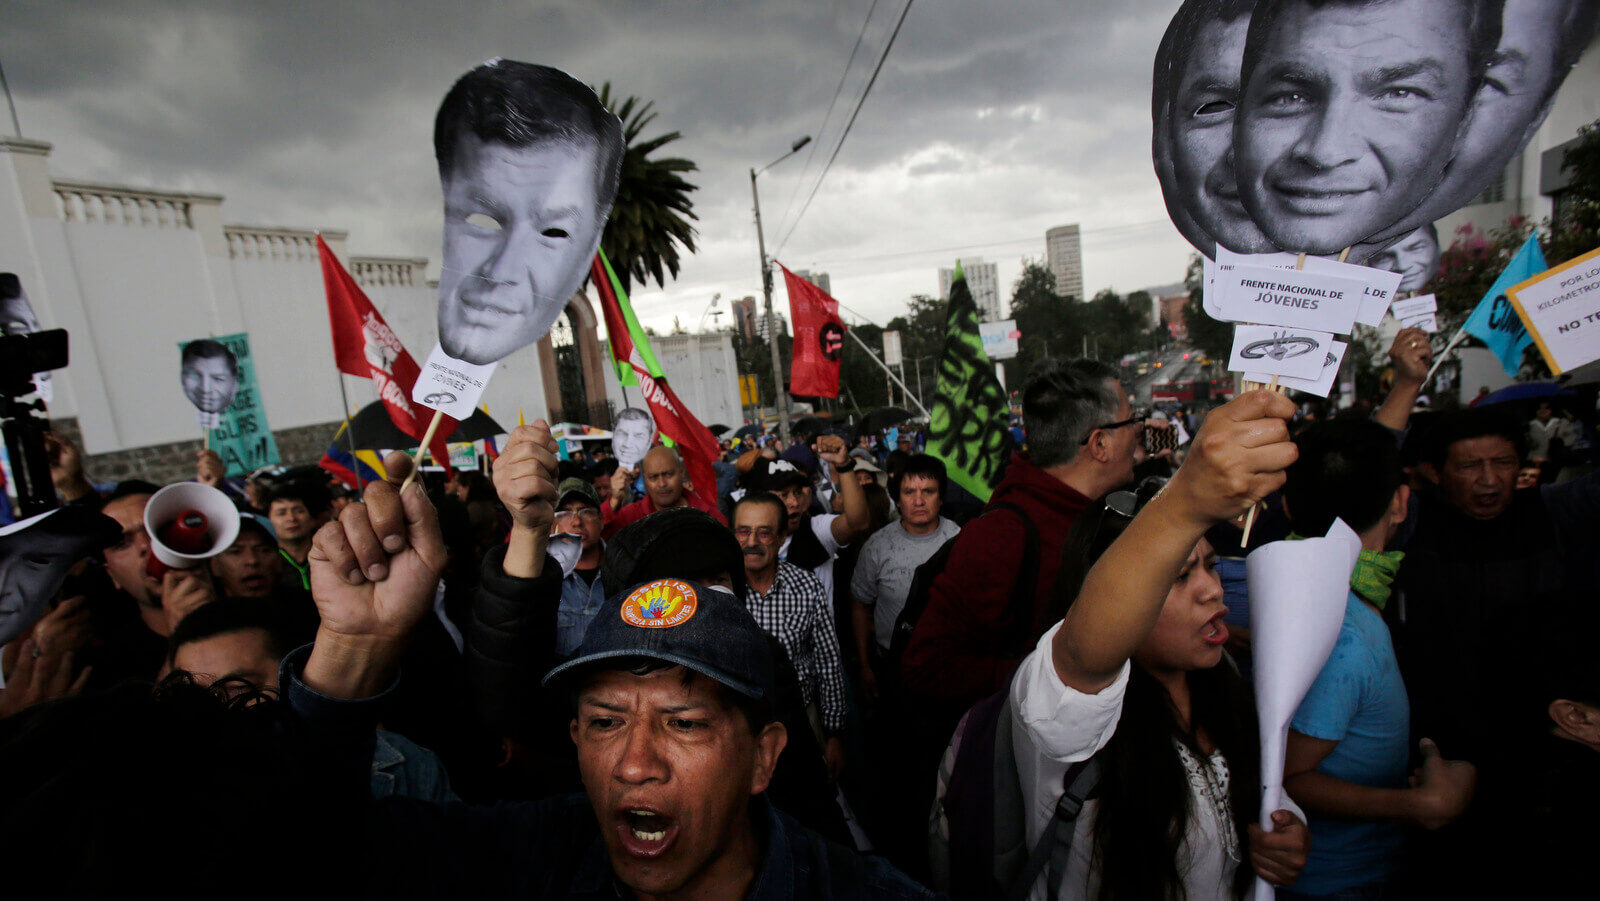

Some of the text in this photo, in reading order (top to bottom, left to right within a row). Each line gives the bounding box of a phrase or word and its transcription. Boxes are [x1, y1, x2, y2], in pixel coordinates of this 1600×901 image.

[1560, 275, 1583, 288] POR
[1240, 279, 1344, 300] FRENTE NACIONAL DE
[1372, 289, 1388, 299] DE
[1254, 291, 1320, 310] JÓVENES
[1558, 320, 1581, 334] NO
[630, 580, 693, 602] ASOLISIL
[649, 619, 664, 627] SIN
